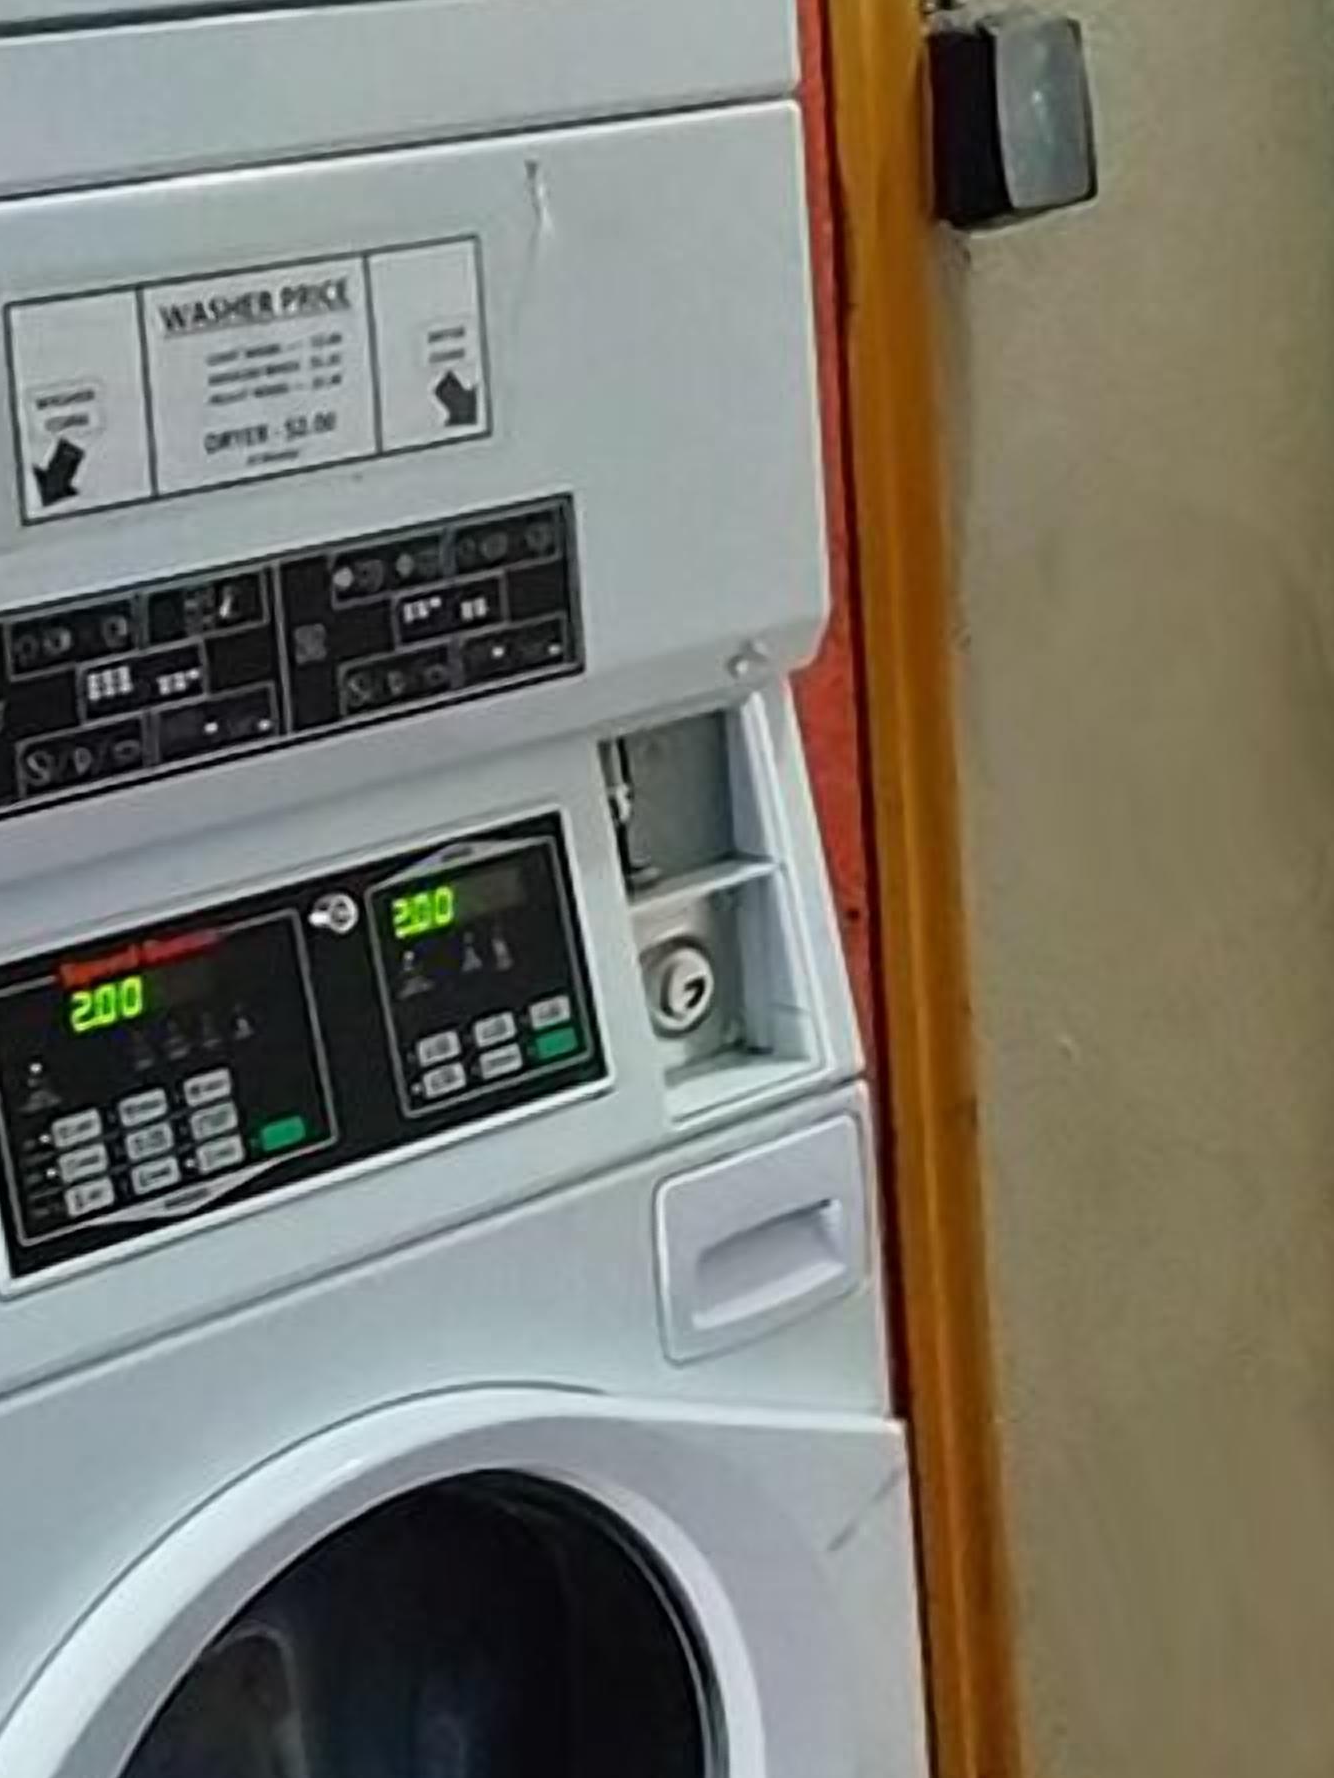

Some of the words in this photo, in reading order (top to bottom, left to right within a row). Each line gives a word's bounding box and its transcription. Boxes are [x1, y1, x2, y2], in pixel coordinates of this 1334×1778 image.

[159, 289, 272, 332] WASHER
[279, 278, 351, 318] PRICE
[204, 424, 268, 455] DRYER
